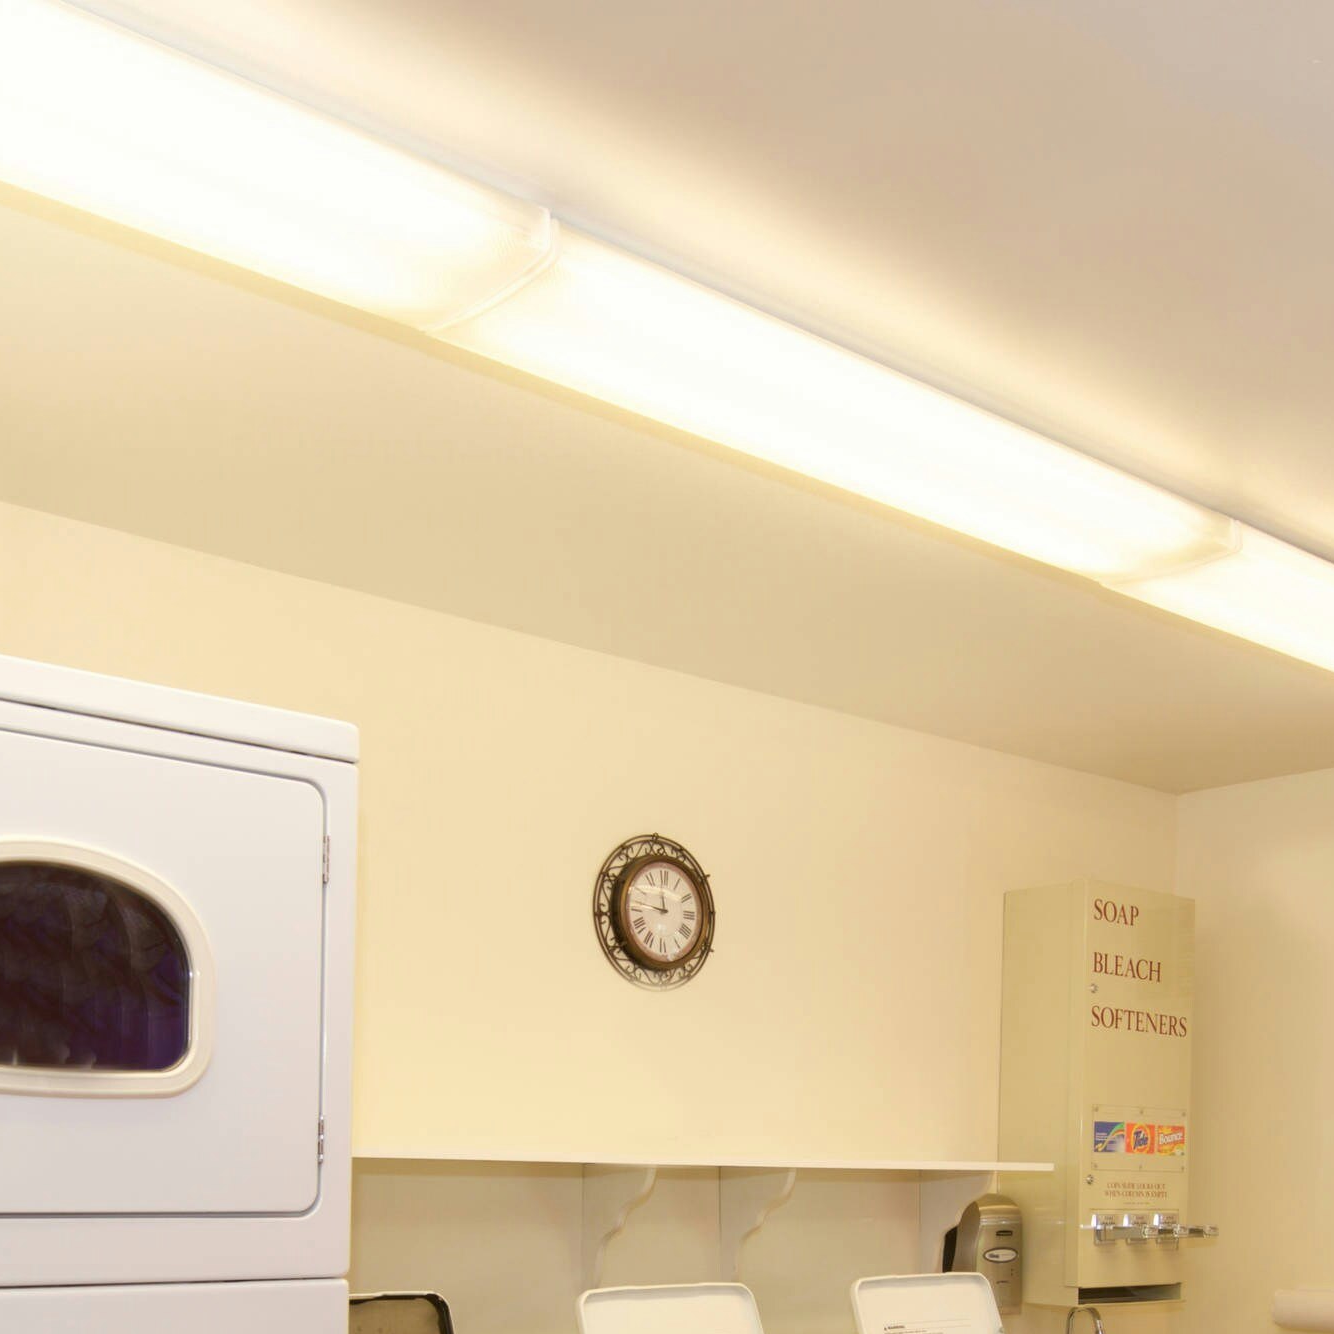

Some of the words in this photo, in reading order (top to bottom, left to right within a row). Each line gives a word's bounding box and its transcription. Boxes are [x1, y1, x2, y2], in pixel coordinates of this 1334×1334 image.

[1093, 898, 1139, 926] SOAP
[1092, 951, 1161, 983] BLEACH
[1091, 1005, 1187, 1038] SOFTENERS
[1133, 1129, 1149, 1149] Tide
[1159, 1131, 1184, 1145] Bounce
